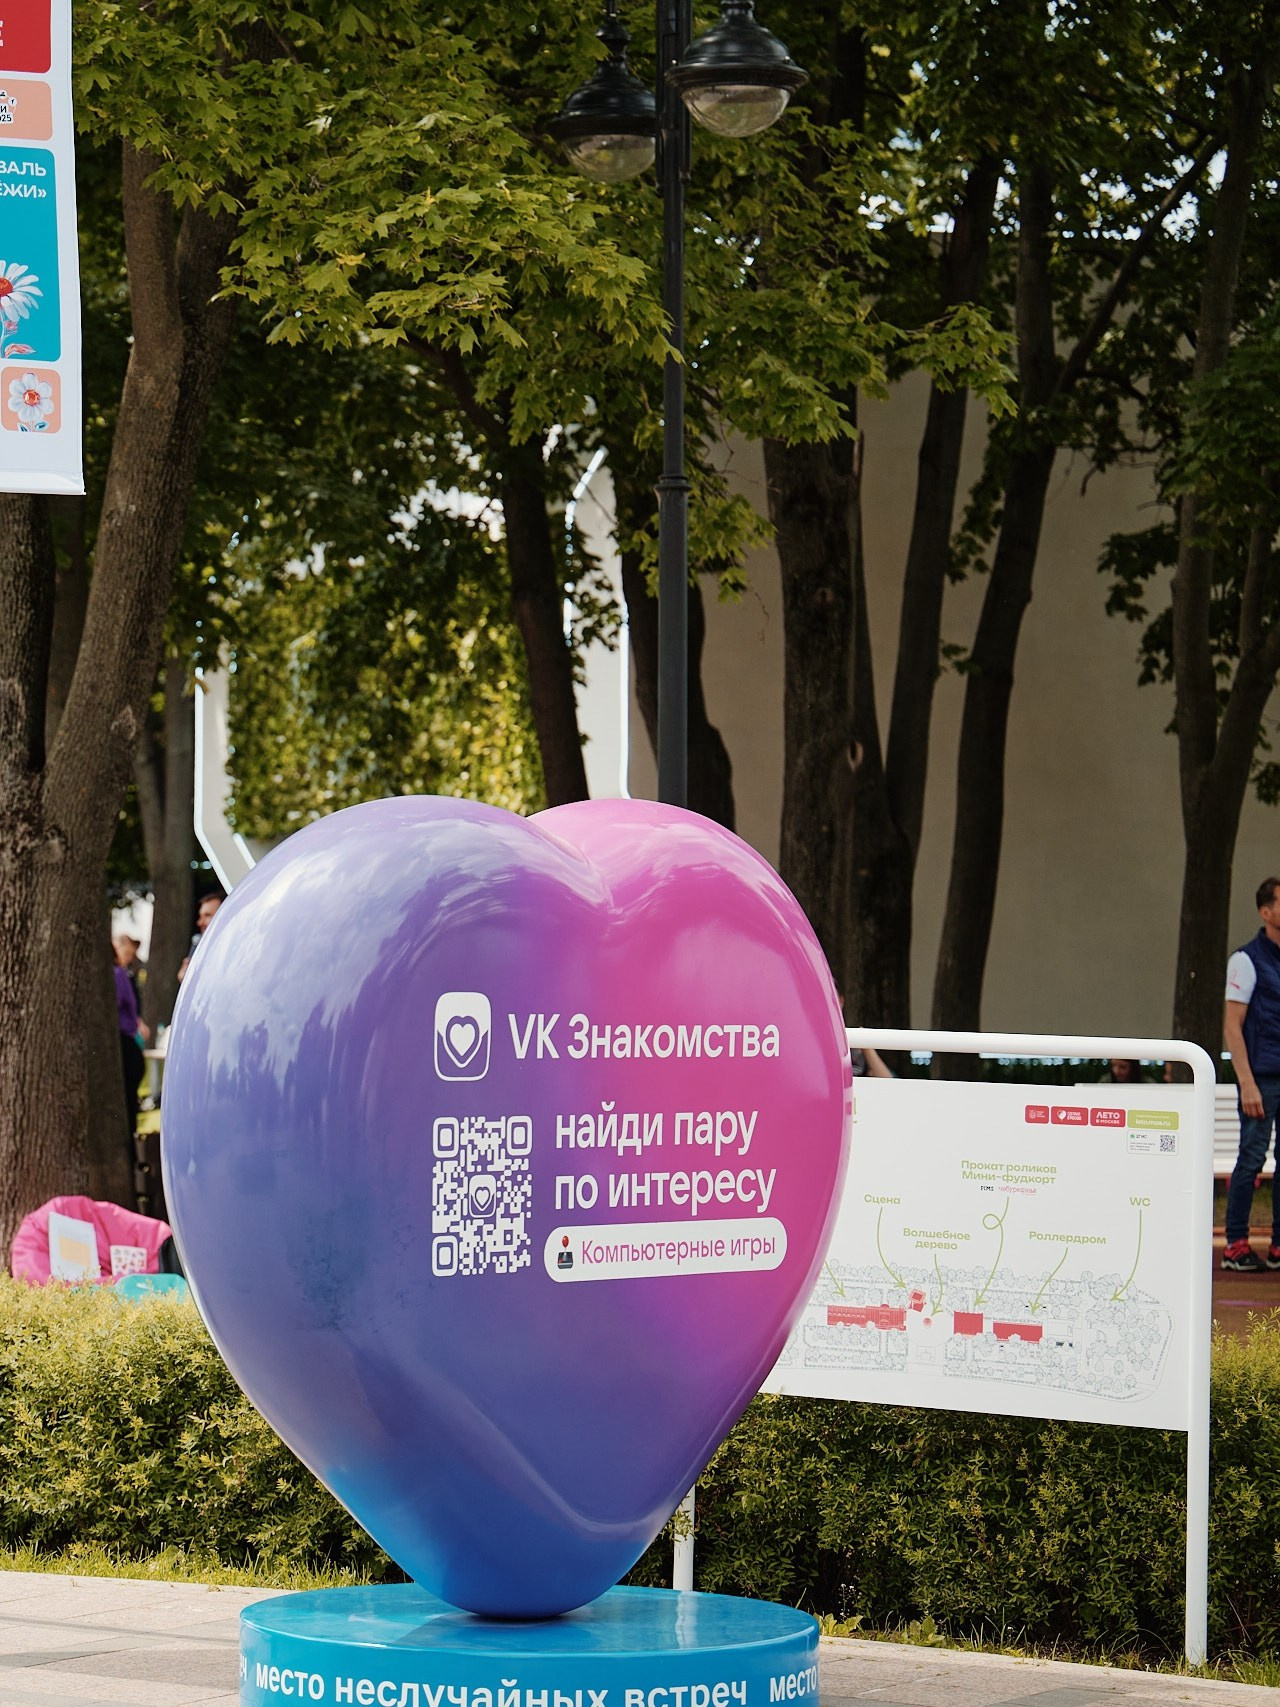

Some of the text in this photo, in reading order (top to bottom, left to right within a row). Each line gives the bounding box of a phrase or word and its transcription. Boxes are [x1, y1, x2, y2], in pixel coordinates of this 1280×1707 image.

[508, 1013, 781, 1060] VK Знакомства
[1096, 1111, 1121, 1119] ЛЕТО
[556, 1101, 758, 1157] найди пару
[961, 1160, 1057, 1174] Прокат роликов
[962, 1171, 1057, 1184] Мини-фудкорт
[555, 1168, 777, 1216] по интересу
[864, 1194, 901, 1205] Сцена
[1129, 1196, 1151, 1207] WC
[903, 1227, 971, 1241] Волшебное
[1029, 1230, 1107, 1244] Роллердром
[581, 1236, 776, 1265] Компьютерные игры
[915, 1240, 958, 1250] дерево
[256, 1662, 325, 1701] место
[335, 1677, 609, 1707] неслучайных
[624, 1680, 747, 1707] встреч
[770, 1665, 817, 1703] место
